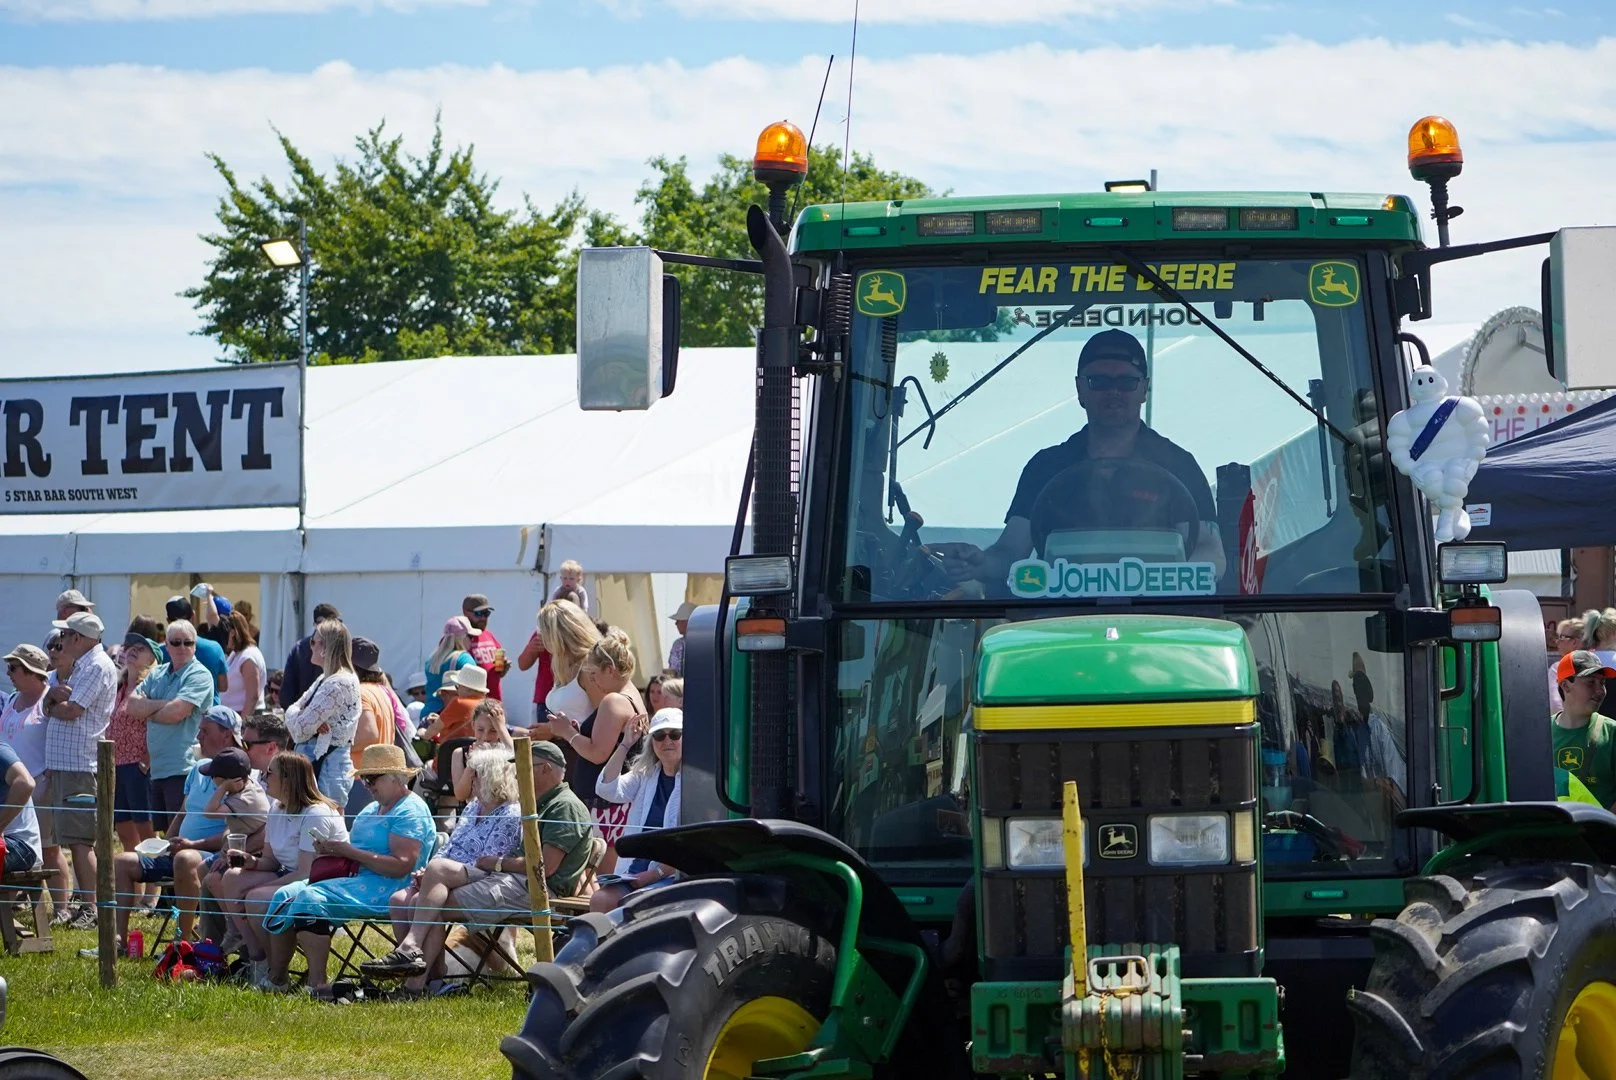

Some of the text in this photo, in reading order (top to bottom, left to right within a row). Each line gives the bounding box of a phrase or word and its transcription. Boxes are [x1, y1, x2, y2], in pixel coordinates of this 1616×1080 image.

[979, 263, 1236, 294] FEAR THE DEERE
[0, 386, 285, 478] R TENT
[5, 487, 138, 502] 5 STAR BAR SOUTH WEST
